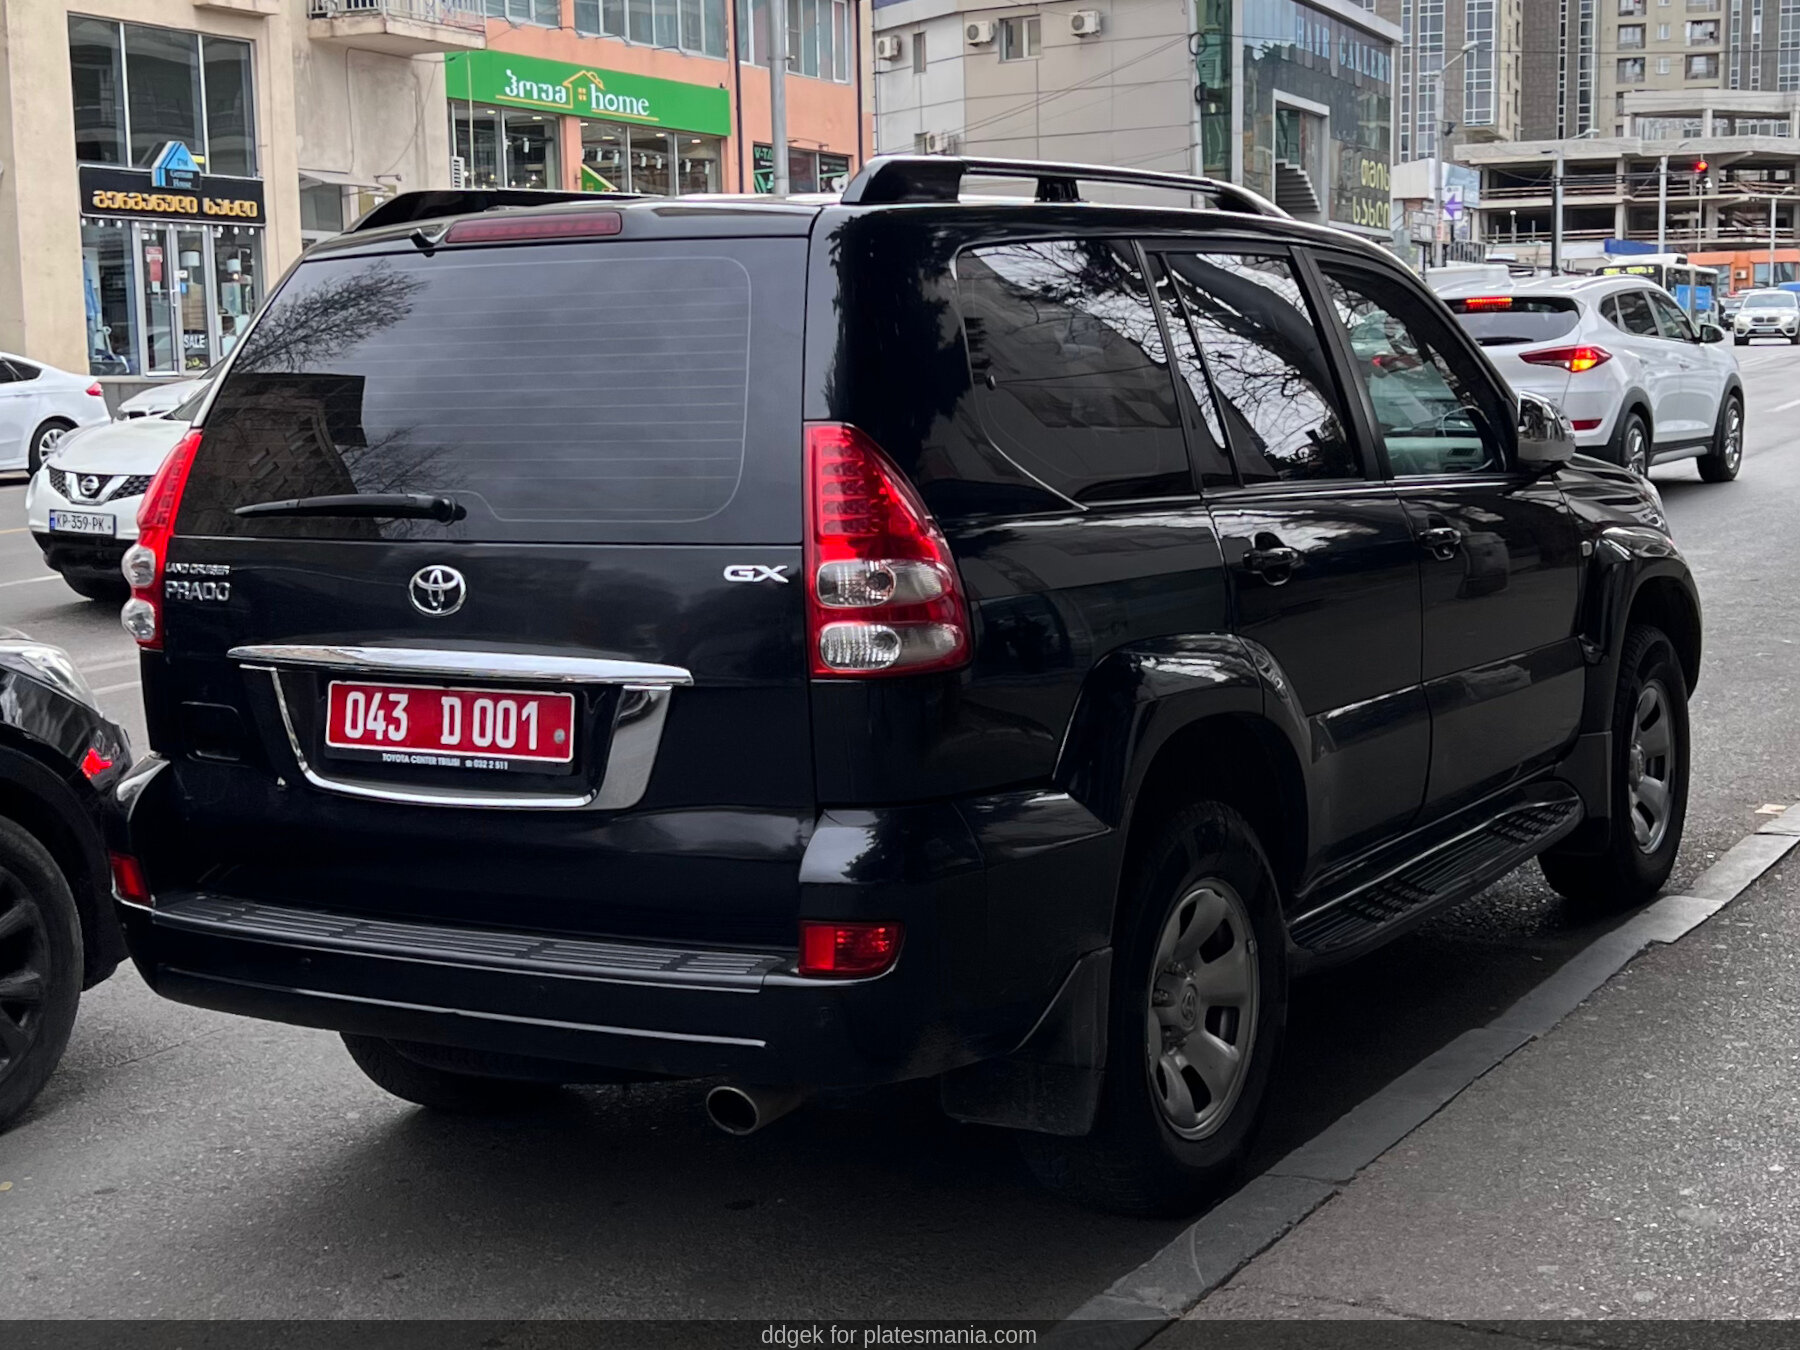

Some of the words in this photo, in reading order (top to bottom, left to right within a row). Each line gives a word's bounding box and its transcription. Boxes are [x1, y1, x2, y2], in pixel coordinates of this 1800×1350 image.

[1295, 15, 1330, 60] HAIR
[505, 69, 567, 104] ჰოუმ
[590, 83, 651, 116] home
[203, 197, 258, 217] სახლი
[183, 334, 206, 349] SALE
[723, 564, 789, 583] GX
[165, 580, 231, 601] PRADO
[344, 691, 409, 742] 043
[440, 696, 462, 746] D
[472, 698, 539, 751] 001
[382, 753, 410, 763] TOYOTA
[410, 755, 437, 766] CENTER
